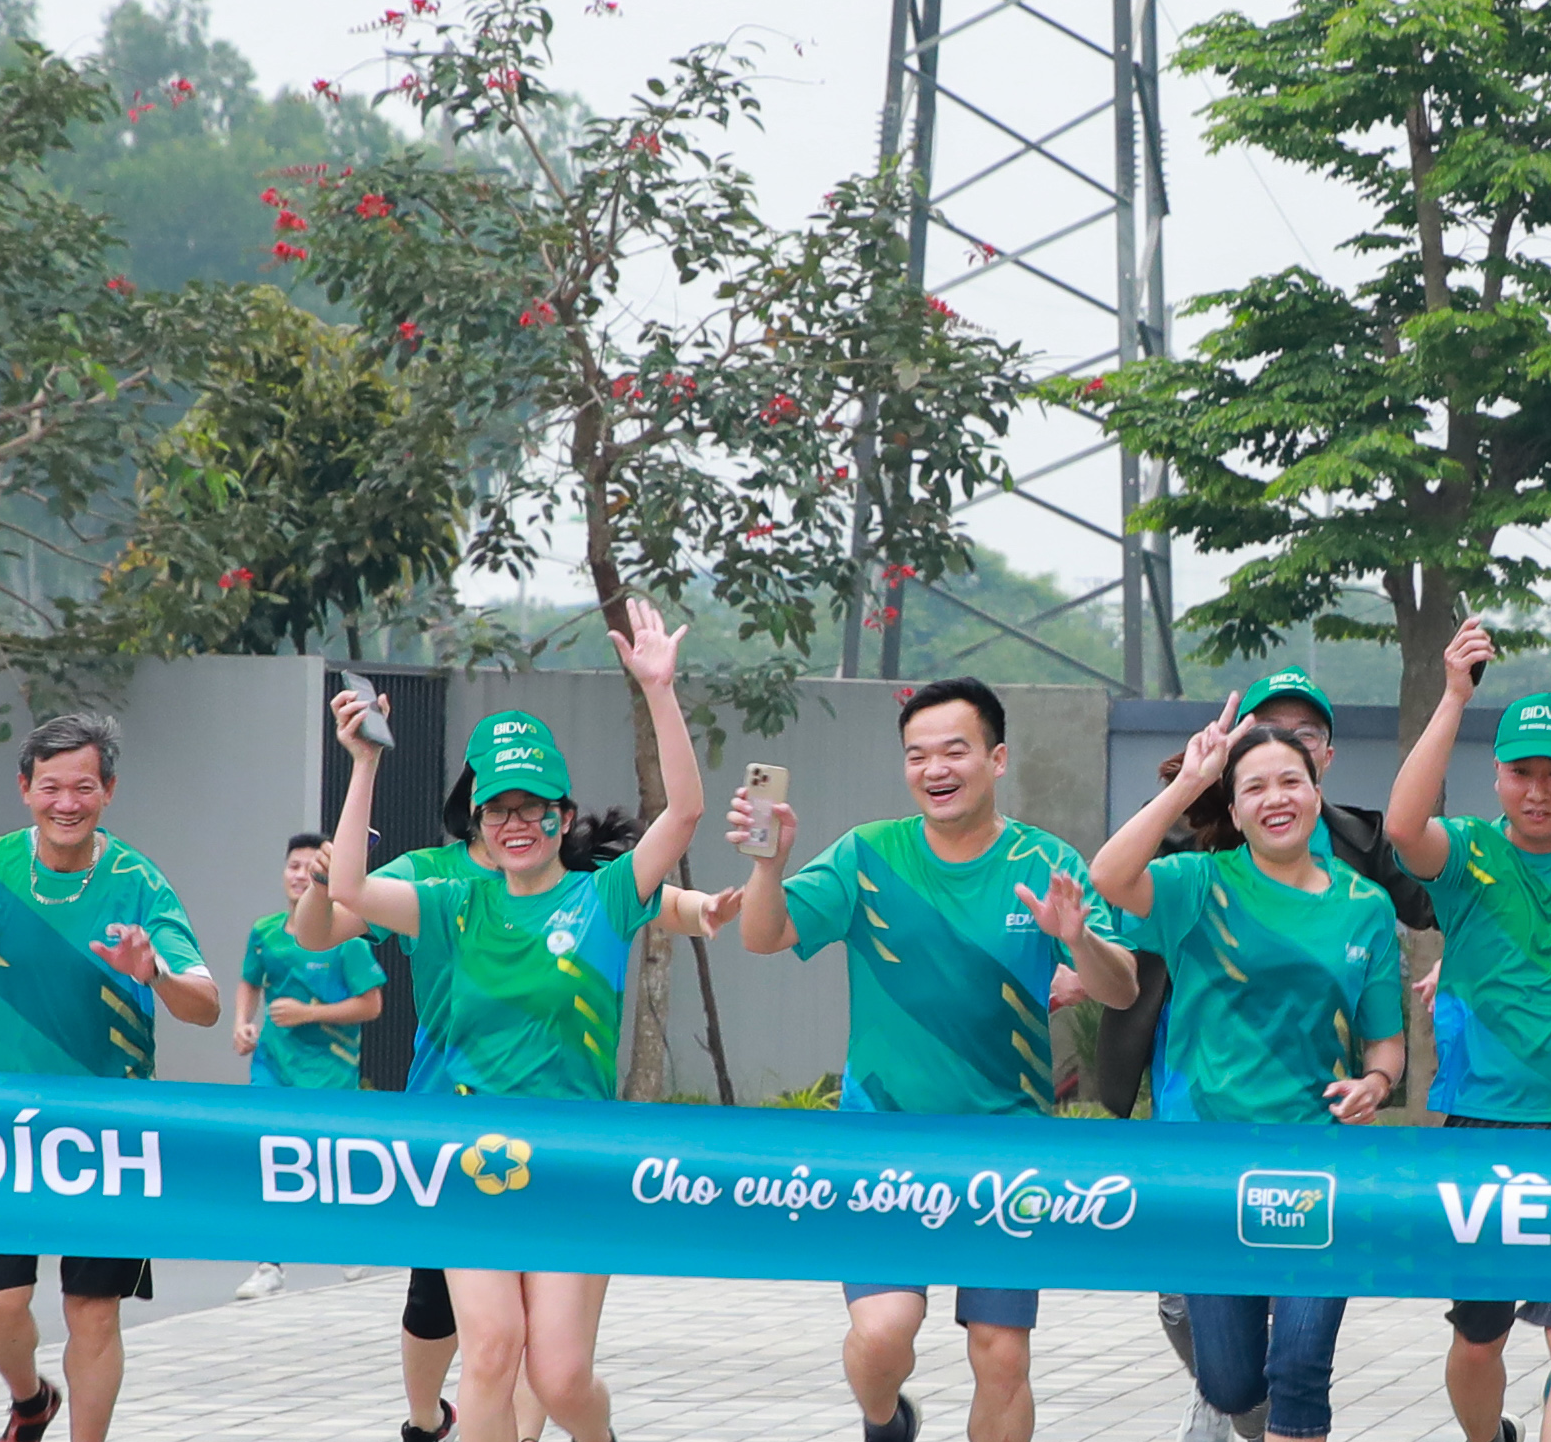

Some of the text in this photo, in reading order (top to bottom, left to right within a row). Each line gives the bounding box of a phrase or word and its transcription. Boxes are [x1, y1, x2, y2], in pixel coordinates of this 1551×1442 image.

[493, 721, 528, 736] BIDV
[494, 746, 533, 763] BIDV
[260, 1135, 461, 1206] BIDV
[633, 1157, 722, 1204] Cho
[734, 1164, 837, 1220] cuộc
[848, 1168, 960, 1229] sống
[1247, 1188, 1300, 1206] BIDV
[1261, 1208, 1306, 1227] Run
